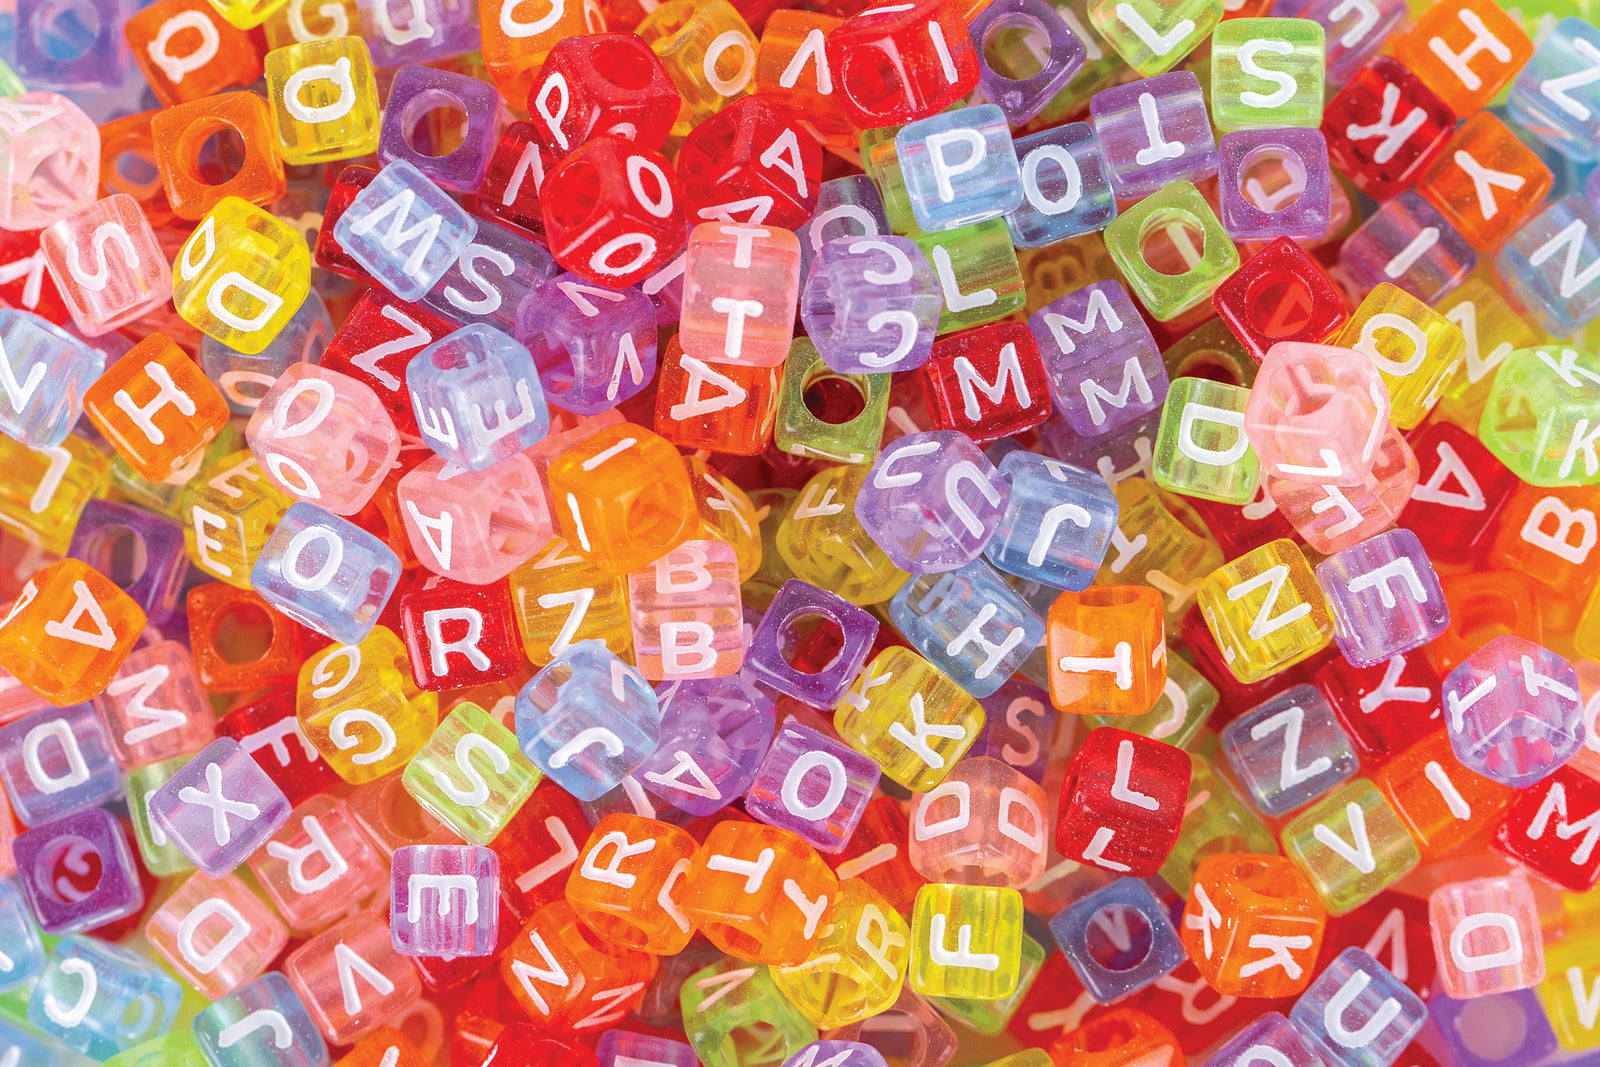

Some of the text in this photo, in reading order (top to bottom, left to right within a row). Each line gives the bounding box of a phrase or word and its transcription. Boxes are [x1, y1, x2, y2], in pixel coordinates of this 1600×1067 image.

[147, 10, 220, 84] Q
[928, 20, 958, 86] I
[1116, 2, 1195, 56] L
[1428, 8, 1512, 91] H
[704, 31, 755, 97] O
[1237, 38, 1298, 108] S
[536, 71, 570, 151] P
[1135, 92, 1186, 166] T
[1346, 82, 1428, 164] K
[627, 155, 673, 219] O
[761, 127, 809, 199] A
[926, 128, 987, 204] P
[1021, 144, 1083, 216] O
[1454, 150, 1526, 220] Y
[66, 221, 140, 291] S
[181, 214, 215, 281] D
[349, 188, 442, 275] M
[589, 231, 657, 277] O
[720, 225, 772, 269] T
[848, 240, 914, 286] C
[1384, 226, 1440, 279] I
[206, 271, 284, 333] D
[443, 243, 516, 316] S
[932, 244, 998, 314] L
[711, 297, 764, 359] T
[857, 310, 919, 369] C
[1042, 288, 1125, 356] M
[114, 361, 197, 445] H
[272, 378, 336, 439] O
[670, 354, 747, 422] A
[953, 342, 1032, 422] M
[1079, 355, 1155, 427] M
[581, 436, 638, 471] I
[874, 440, 941, 490] U
[1177, 401, 1252, 468] D
[792, 482, 846, 521] F
[945, 460, 1003, 541] U
[1410, 443, 1486, 512] A
[193, 505, 232, 578] E
[406, 500, 455, 572] A
[566, 492, 592, 554] I
[1027, 503, 1092, 567] J
[1520, 494, 1598, 568] B
[281, 525, 344, 592] O
[656, 544, 713, 594] B
[1347, 556, 1428, 609] F
[44, 580, 117, 651] A
[1226, 564, 1312, 641] N
[312, 644, 361, 699] G
[423, 607, 491, 676] R
[660, 621, 718, 675] B
[946, 603, 1026, 680] H
[1059, 641, 1134, 690] T
[107, 664, 188, 745] M
[1360, 652, 1431, 714] Y
[23, 713, 91, 795] D
[329, 708, 397, 765] G
[548, 727, 625, 769] J
[888, 692, 966, 770] K
[1001, 694, 1046, 768] S
[1250, 706, 1333, 791] Z
[434, 732, 511, 808] S
[644, 750, 722, 801] A
[781, 750, 848, 821] O
[1110, 740, 1161, 812] L
[1424, 760, 1472, 821] I
[178, 762, 261, 848] X
[915, 780, 970, 842] D
[998, 787, 1043, 854] D
[1312, 801, 1377, 875] V
[1525, 782, 1600, 867] M
[266, 815, 349, 895] R
[515, 814, 579, 894] L
[580, 830, 655, 889] R
[706, 847, 775, 894] T
[1082, 826, 1132, 872] L
[407, 873, 479, 924] E
[1186, 882, 1221, 959] K
[176, 897, 252, 976] D
[855, 903, 906, 980] R
[931, 912, 1001, 970] F
[1240, 933, 1313, 980] K
[1449, 912, 1524, 973] D
[43, 957, 98, 1029] C
[335, 944, 395, 1017] V
[1323, 969, 1402, 1049] U
[219, 1009, 293, 1051] J
